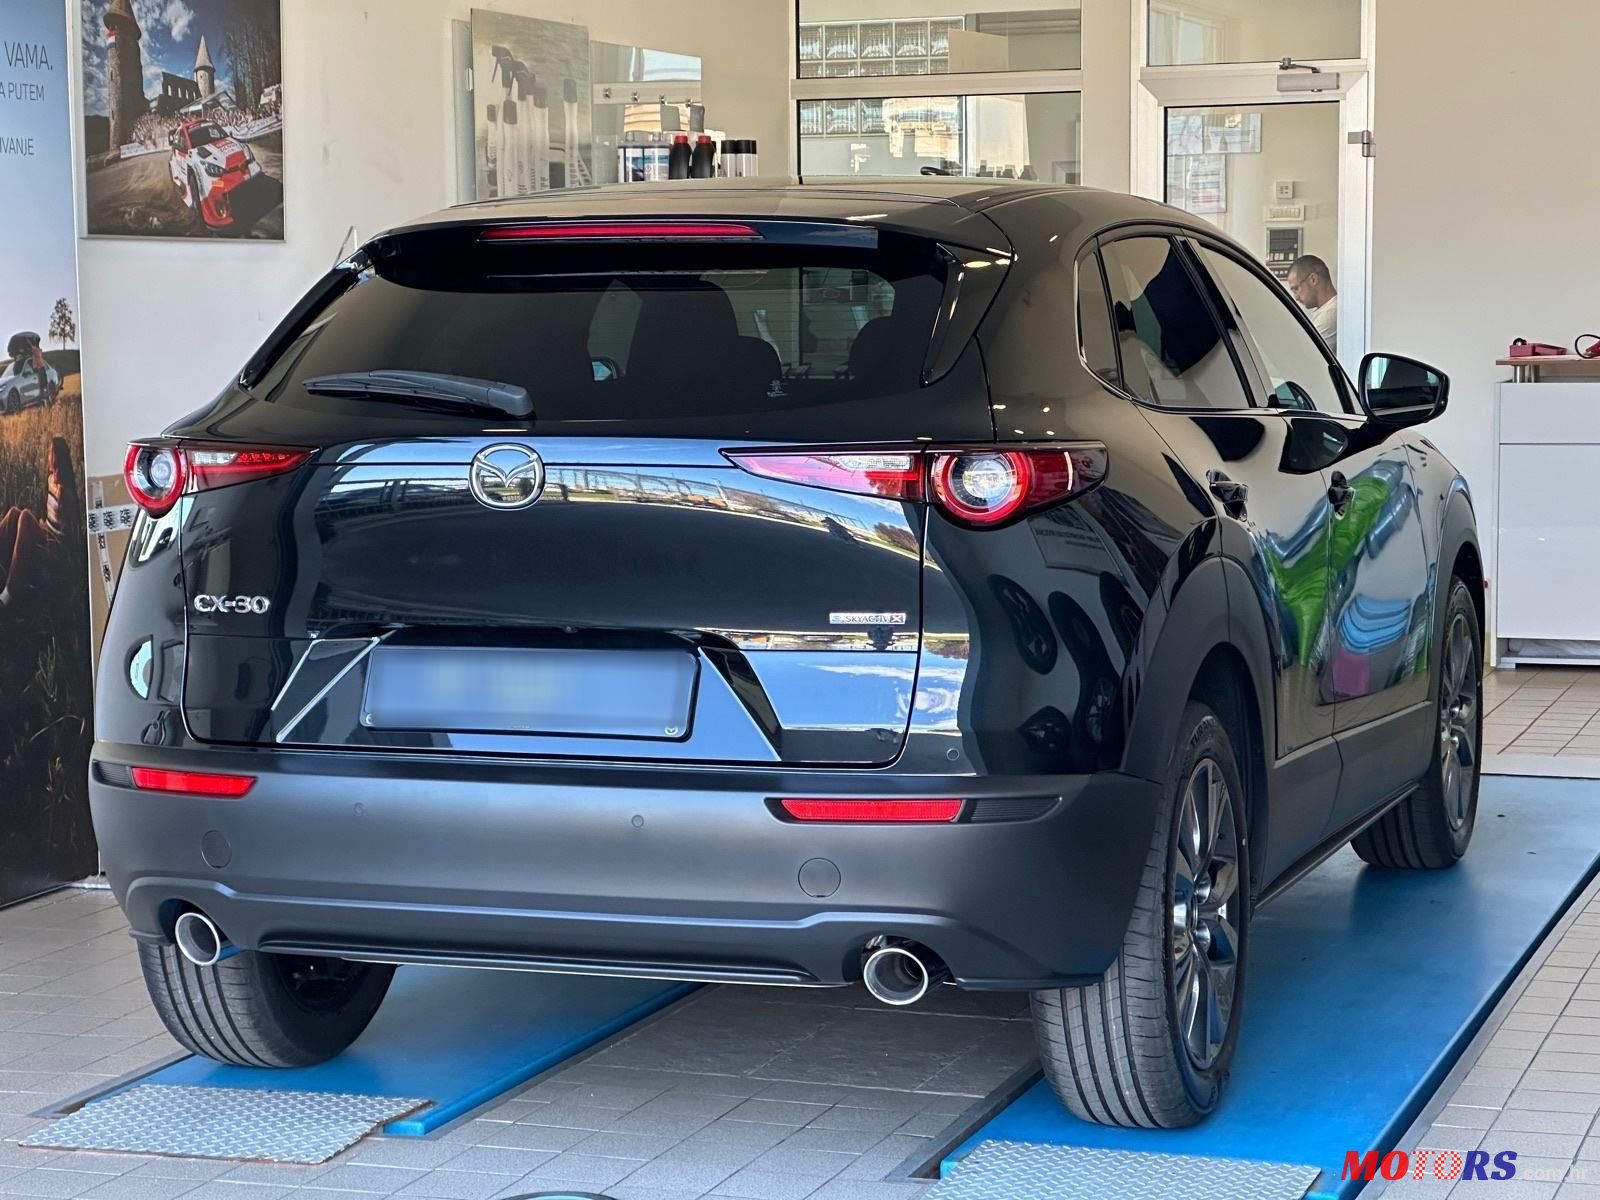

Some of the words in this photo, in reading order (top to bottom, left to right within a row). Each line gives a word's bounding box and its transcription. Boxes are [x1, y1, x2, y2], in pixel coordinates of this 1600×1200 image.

[3, 40, 54, 71] VAMA.
[8, 82, 45, 102] PUTEM
[193, 593, 271, 615] CX-30
